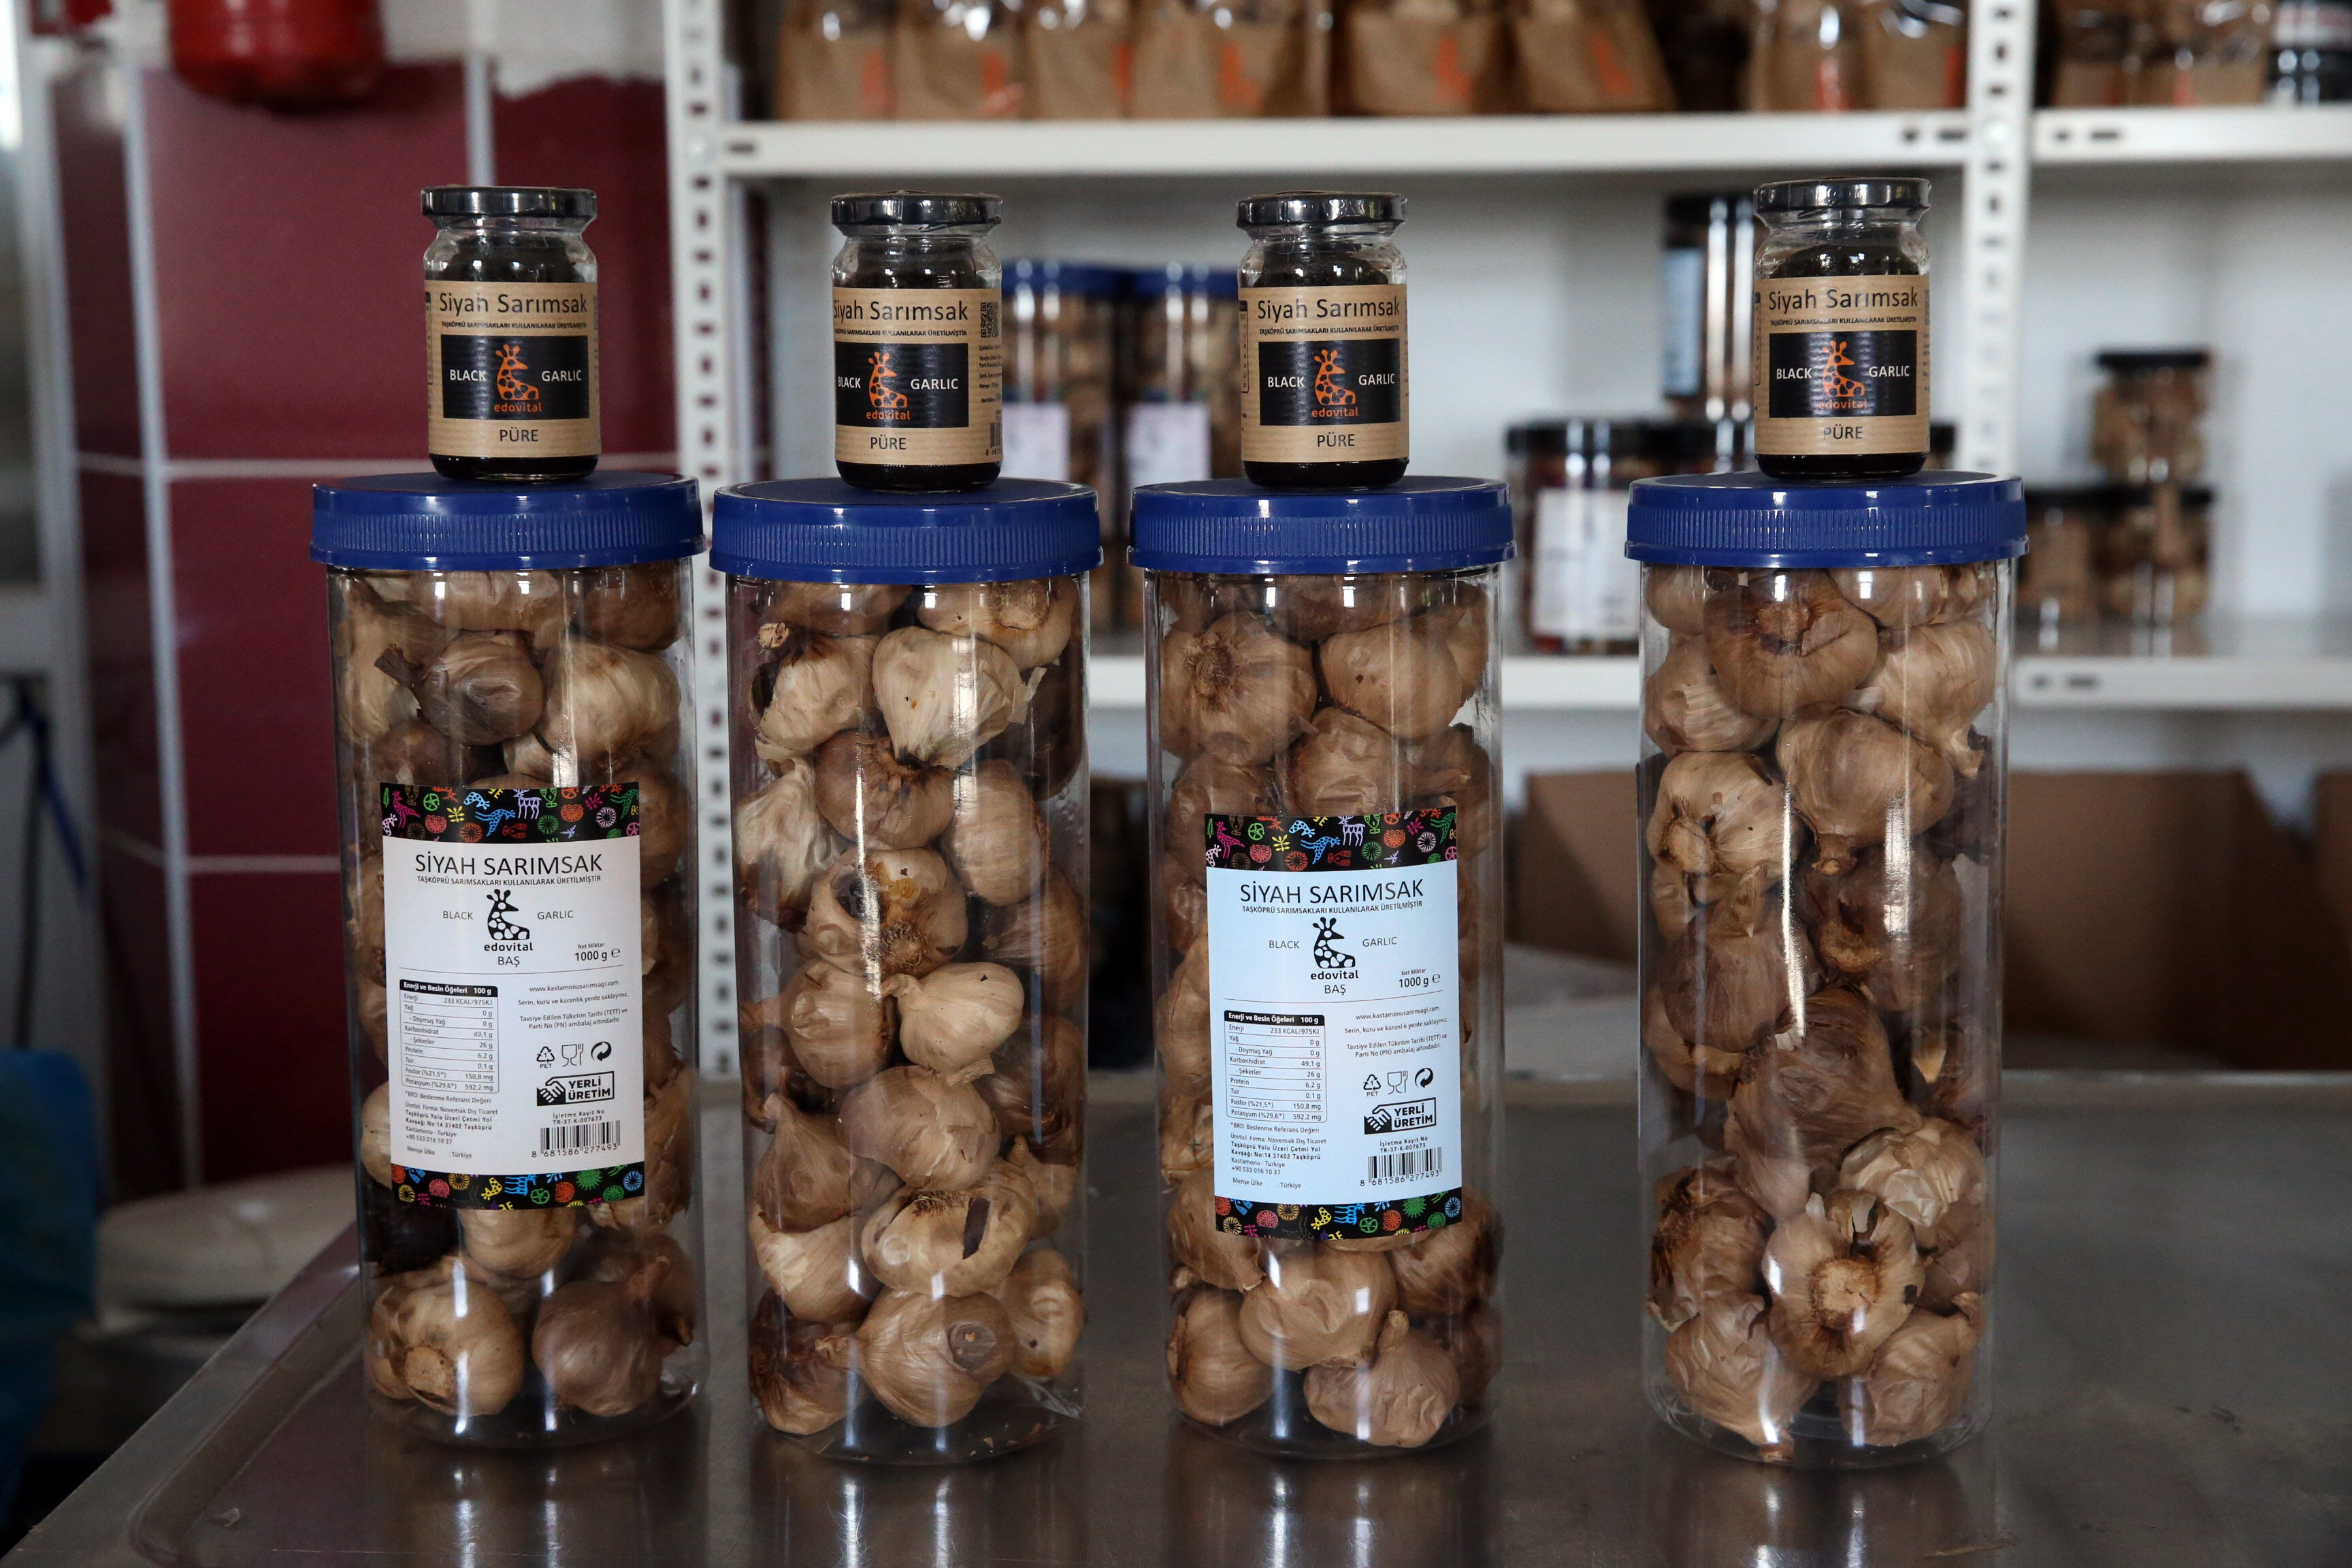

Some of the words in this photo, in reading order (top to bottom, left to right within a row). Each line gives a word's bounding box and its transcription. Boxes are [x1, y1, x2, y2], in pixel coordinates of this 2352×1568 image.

[440, 293, 489, 316] Siyah
[497, 293, 587, 313] Sarımsak
[1769, 289, 1816, 314] Siyah
[1826, 287, 1918, 309] Sarımsak
[834, 299, 863, 323] Siyah
[870, 300, 968, 321] Sarımsak
[1258, 299, 1307, 323] Siyah
[1316, 296, 1400, 318] Sarımsak
[450, 369, 486, 382] BLACK
[541, 370, 581, 382] GARLIC
[1776, 368, 1812, 379] BLACK
[1869, 365, 1910, 377] GARLIC
[838, 376, 861, 389] BLACK
[911, 378, 959, 390] GARLIC
[1268, 376, 1305, 388] BLACK
[1358, 374, 1395, 385] GARLIC
[493, 402, 542, 412] edovital
[1819, 399, 1867, 410] edovital
[866, 410, 911, 420] edovital
[1311, 407, 1358, 417] edovital
[500, 427, 539, 442] PÜRE
[1823, 424, 1863, 439] PÜRE
[870, 434, 906, 450] PÜRE
[1317, 432, 1356, 447] PÜRE
[416, 851, 475, 875] SİYAH
[484, 851, 602, 877] SARIMSAK
[557, 874, 601, 885] ÜRETİLMİŞTİR
[1241, 881, 1301, 904] SİYAH
[1309, 879, 1423, 904] SARIMSAK
[1381, 900, 1422, 911] ÜRETİLMİŞTİR
[537, 910, 574, 921] GARLIC
[483, 941, 534, 952] edovital
[1362, 936, 1397, 947] GARLIC
[497, 956, 520, 968] BAŞ
[574, 950, 600, 962] 1000
[1310, 969, 1359, 980] edovital
[1399, 977, 1422, 988] 1000
[1324, 984, 1346, 996] BAŞ
[569, 1075, 601, 1090] YERLİ
[568, 1087, 610, 1100] ÜRETİM
[1394, 1102, 1424, 1117] YERLİ
[1394, 1114, 1433, 1128] ÜRETİM
[585, 1143, 617, 1154] 277493
[1410, 1170, 1439, 1181] 277493
